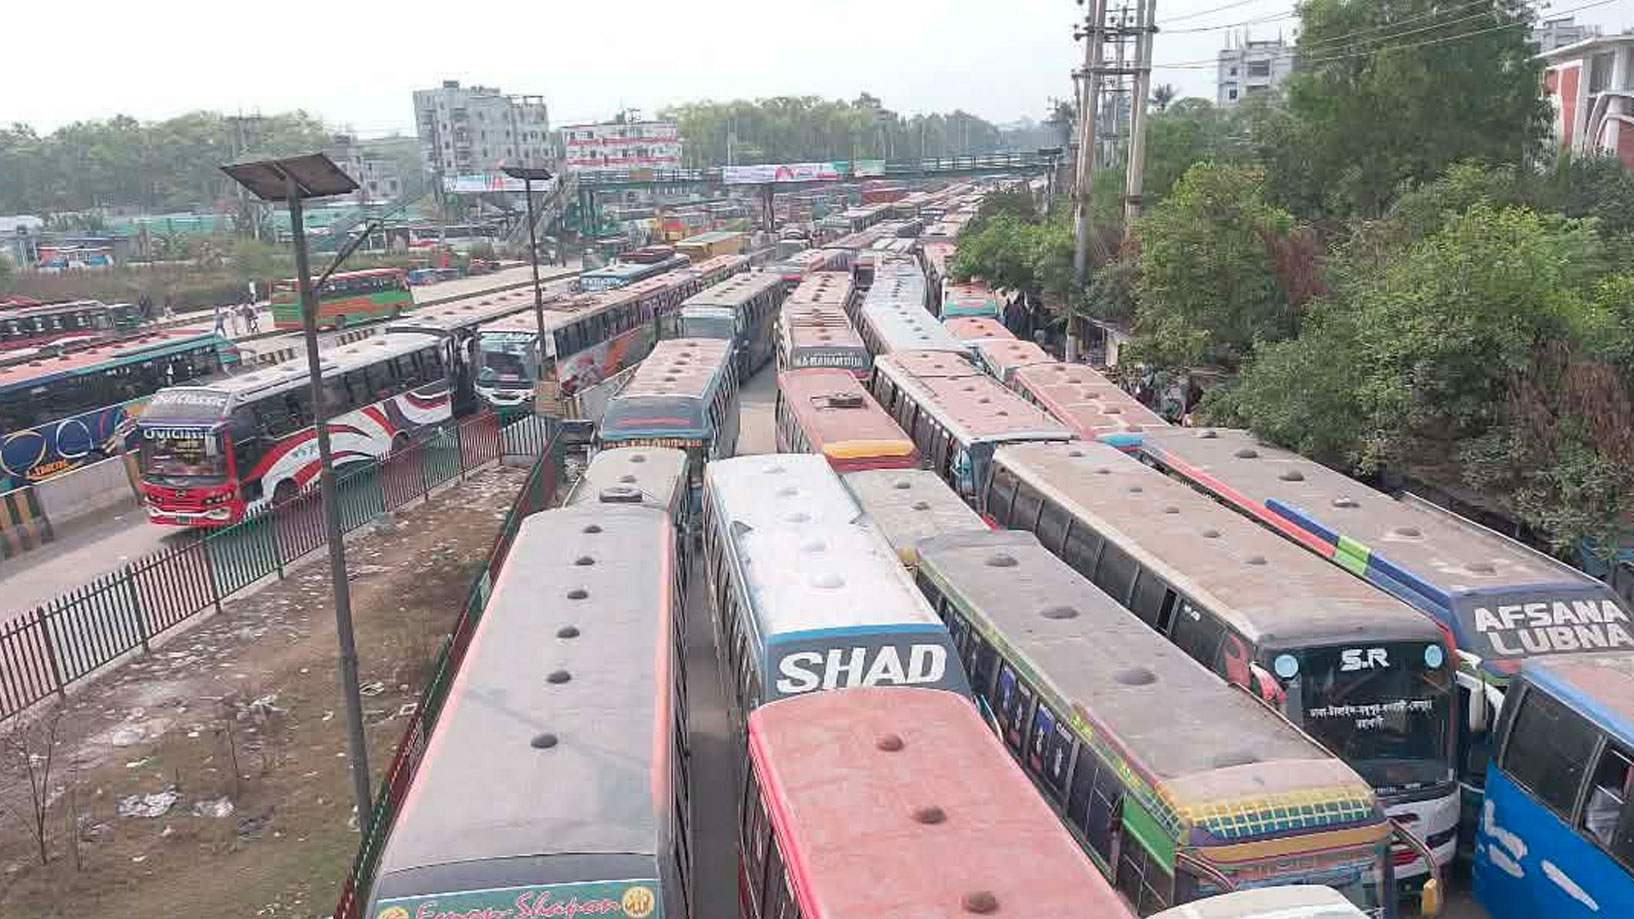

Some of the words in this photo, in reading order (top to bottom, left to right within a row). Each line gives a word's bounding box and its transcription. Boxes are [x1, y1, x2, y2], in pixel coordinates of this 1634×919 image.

[1474, 600, 1631, 632] AFSANA
[1488, 622, 1634, 655] LUBNA
[776, 644, 947, 693] SHAD
[1340, 648, 1390, 671] S.R
